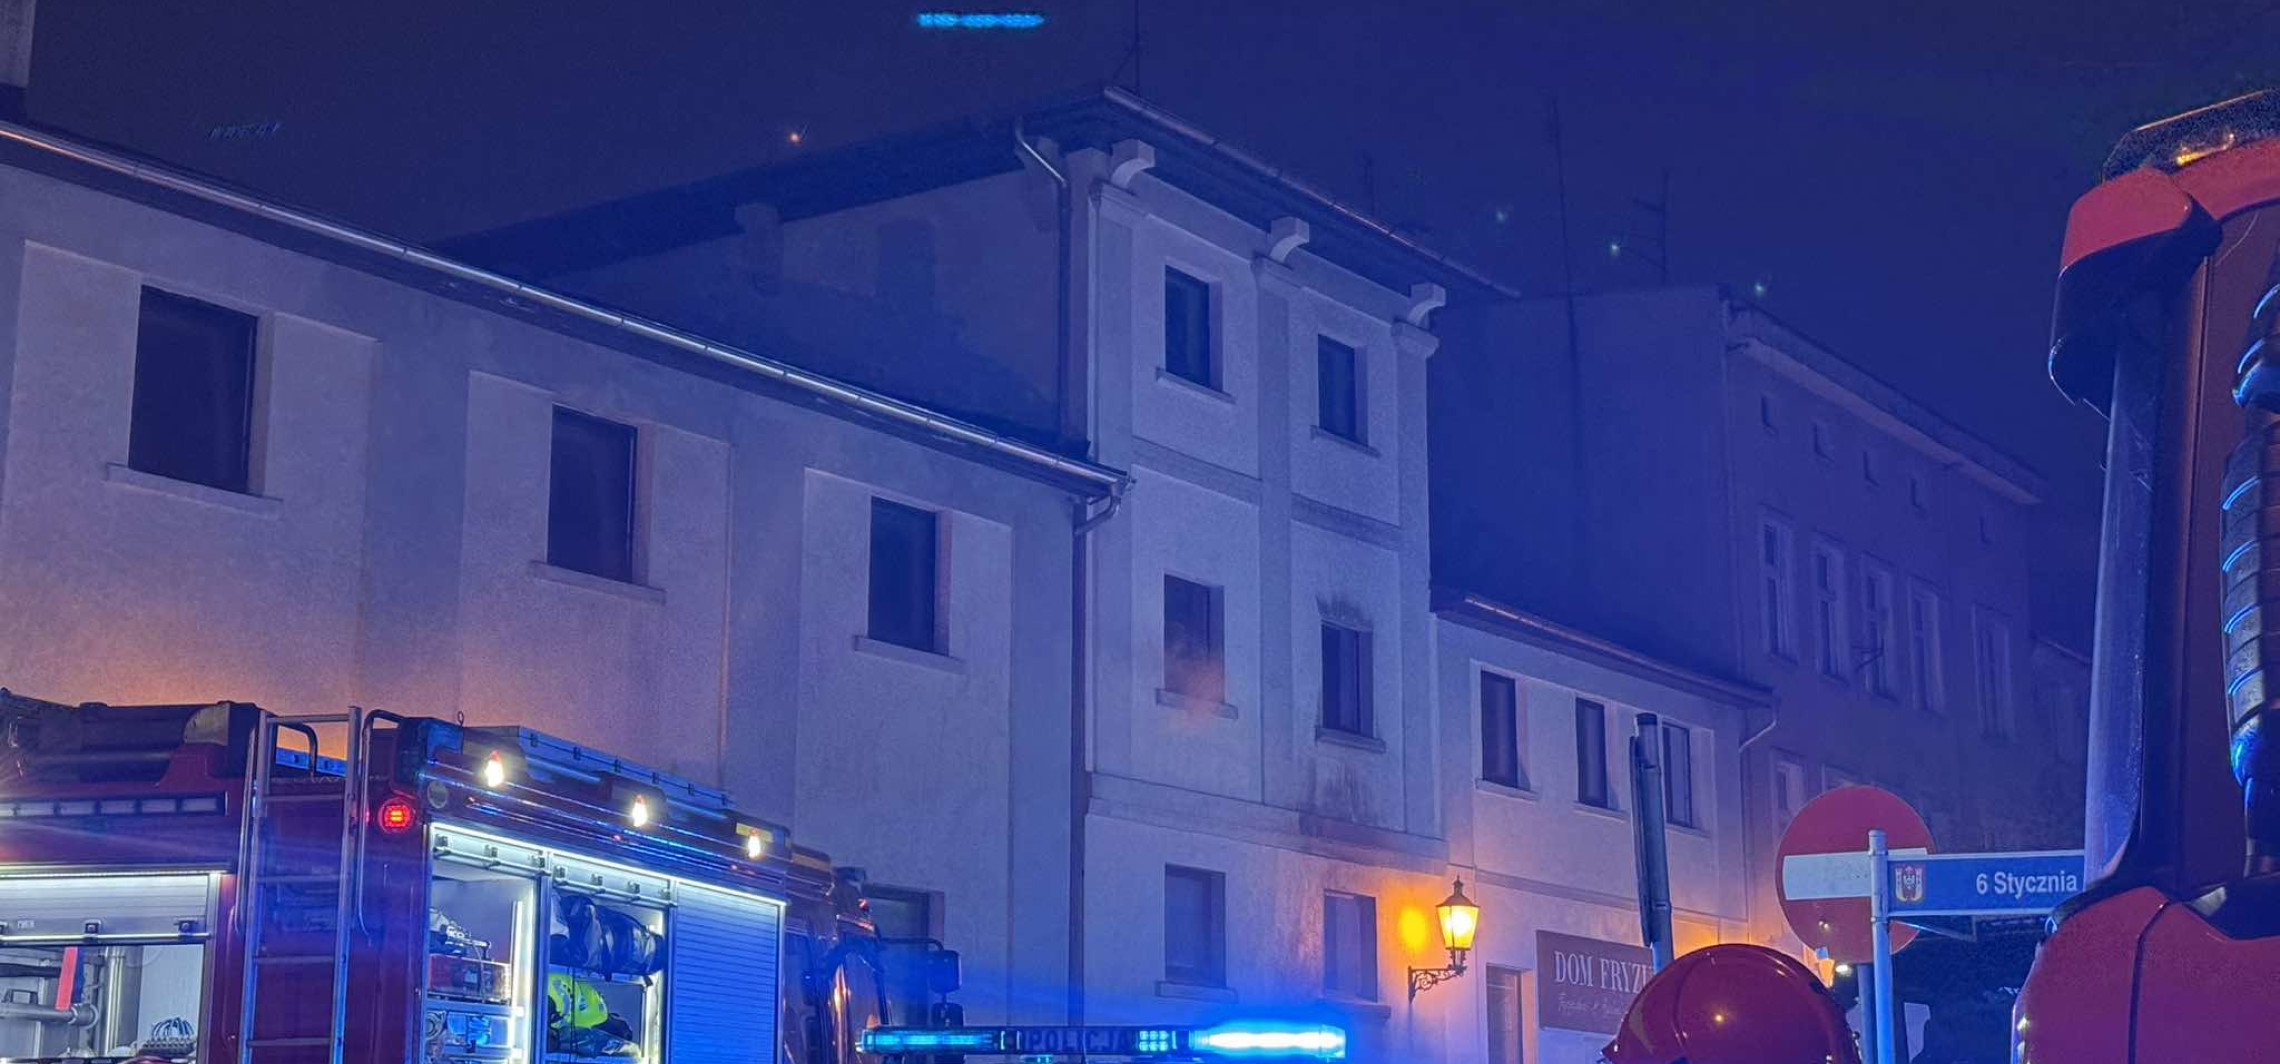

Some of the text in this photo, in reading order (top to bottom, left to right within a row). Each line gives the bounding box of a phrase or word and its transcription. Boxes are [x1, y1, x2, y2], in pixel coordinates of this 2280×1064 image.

[1976, 870, 2077, 899] 6 Stycznia
[1554, 951, 1594, 986] DOM
[1030, 1030, 1132, 1051] POLICJA
